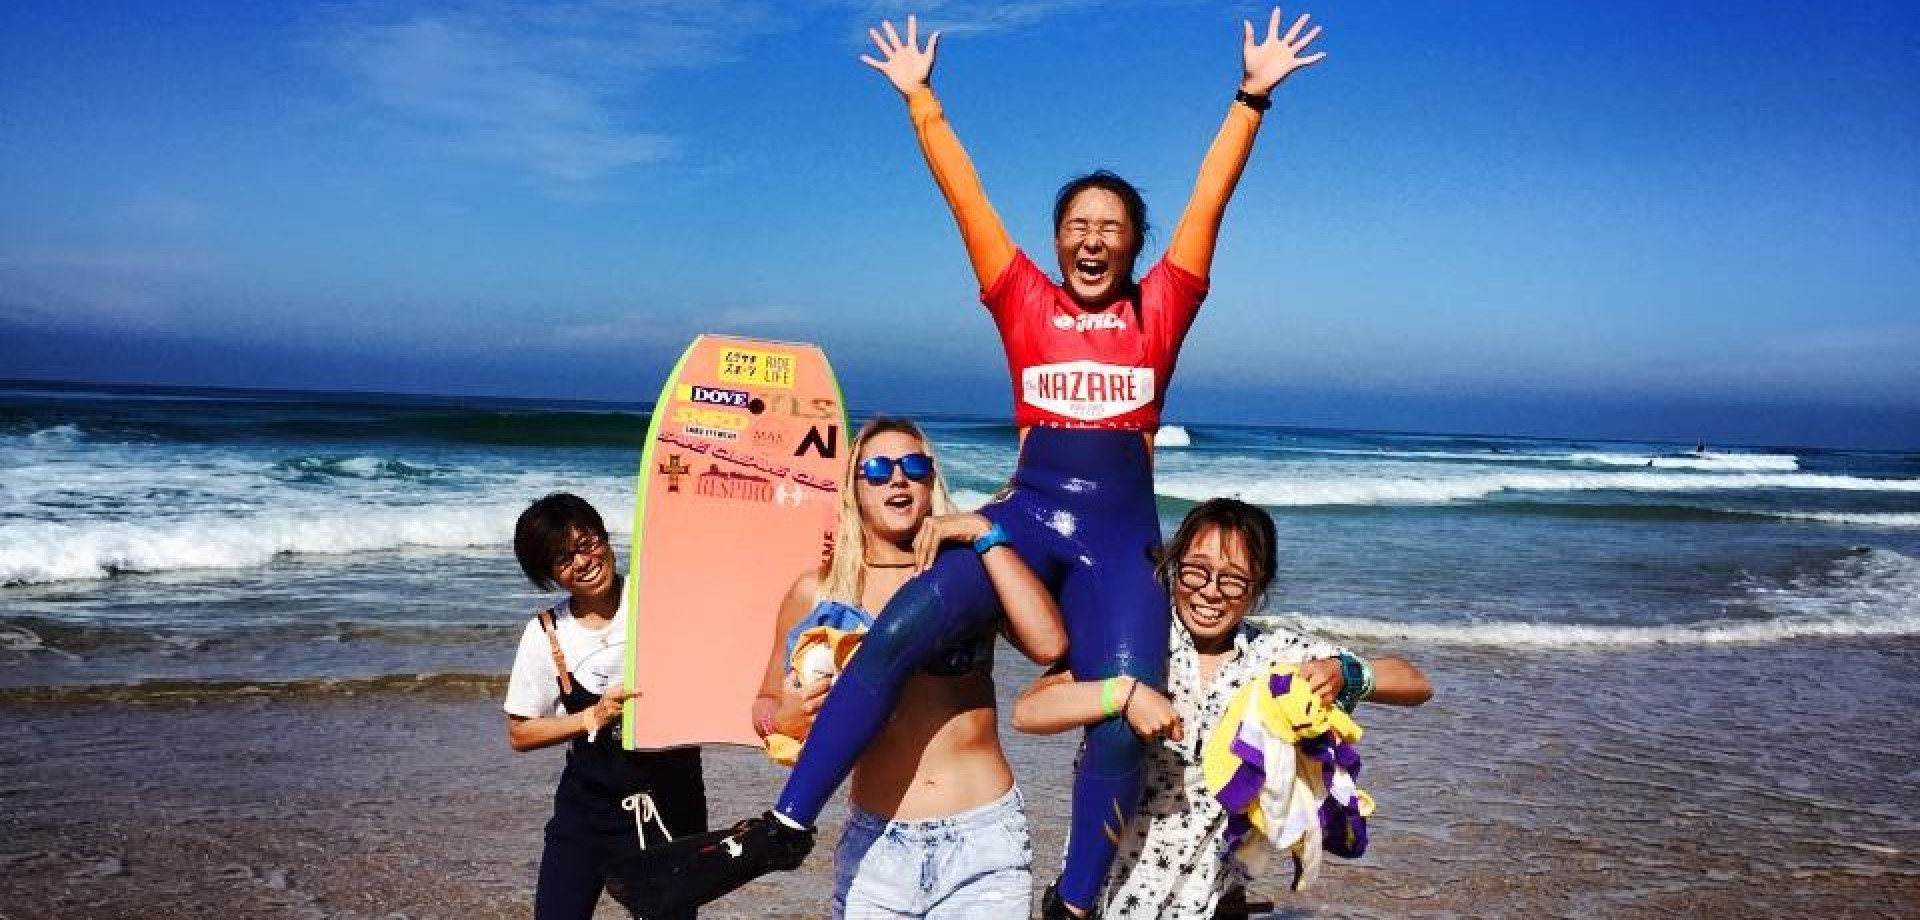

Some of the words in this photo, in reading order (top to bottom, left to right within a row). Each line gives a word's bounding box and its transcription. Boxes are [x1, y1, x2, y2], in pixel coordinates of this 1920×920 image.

[766, 356, 790, 371] RIDE
[764, 370, 791, 384] LIFE
[695, 387, 747, 406] DOVE
